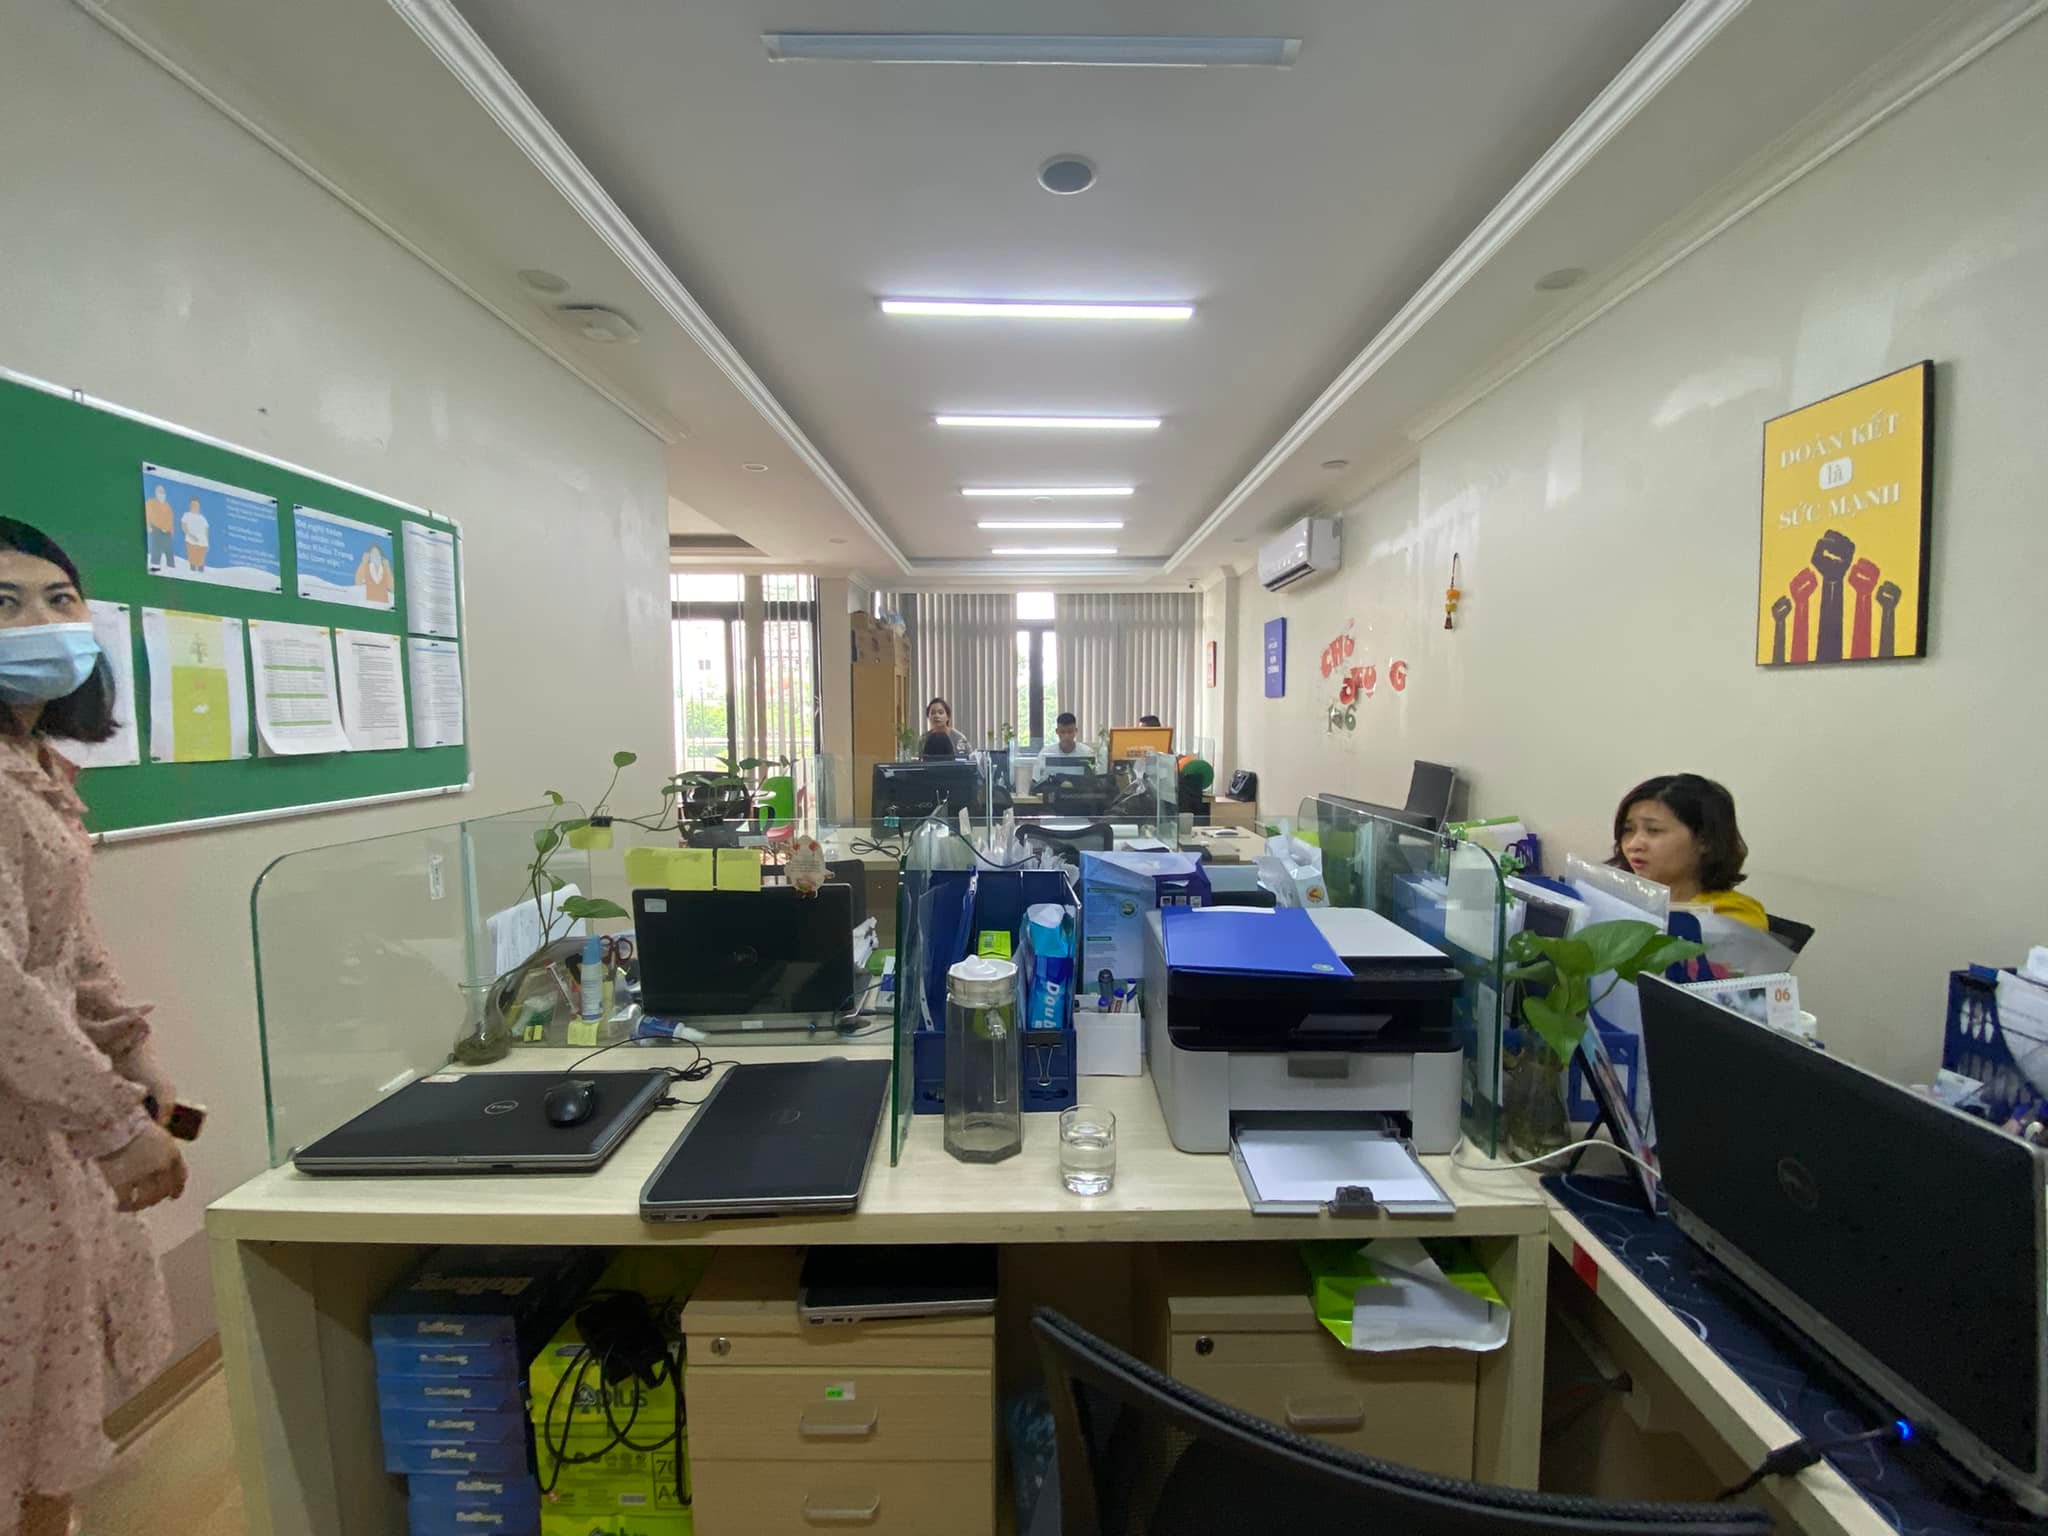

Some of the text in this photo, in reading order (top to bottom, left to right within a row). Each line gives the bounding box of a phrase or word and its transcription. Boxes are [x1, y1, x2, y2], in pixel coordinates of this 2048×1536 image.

[1850, 408, 1900, 446] KẾT
[1826, 464, 1844, 485] là
[1778, 481, 1901, 529] SỨC MẠNH
[1775, 988, 1791, 1002] 06
